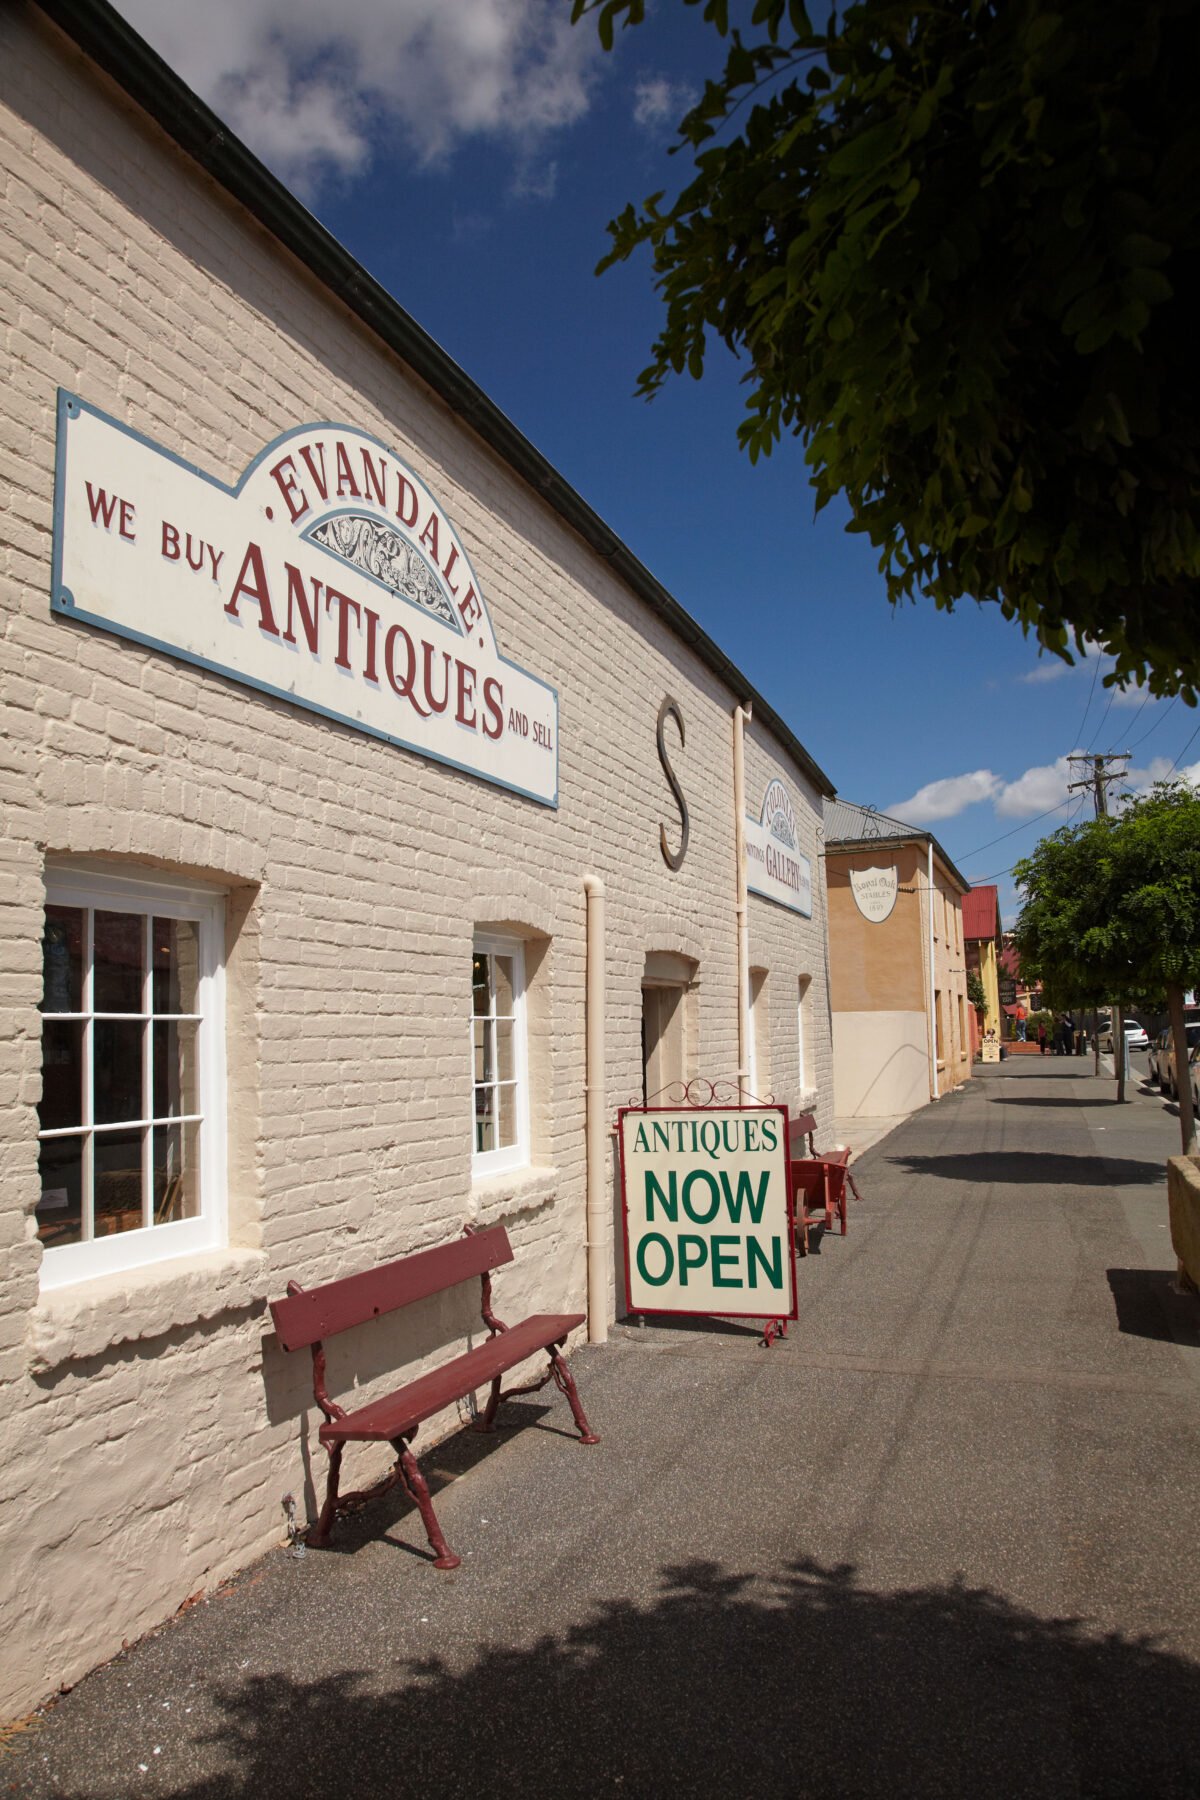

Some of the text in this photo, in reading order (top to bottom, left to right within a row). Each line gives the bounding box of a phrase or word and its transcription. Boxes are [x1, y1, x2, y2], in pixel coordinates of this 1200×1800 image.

[269, 441, 482, 633] EVANDALE
[85, 480, 553, 751] WE BUY ANTIQUES AND SELL
[765, 844, 800, 891] GALLERY
[633, 1119, 778, 1159] ANTIQUES
[644, 1169, 770, 1224] NOW
[636, 1232, 783, 1289] OPEN
